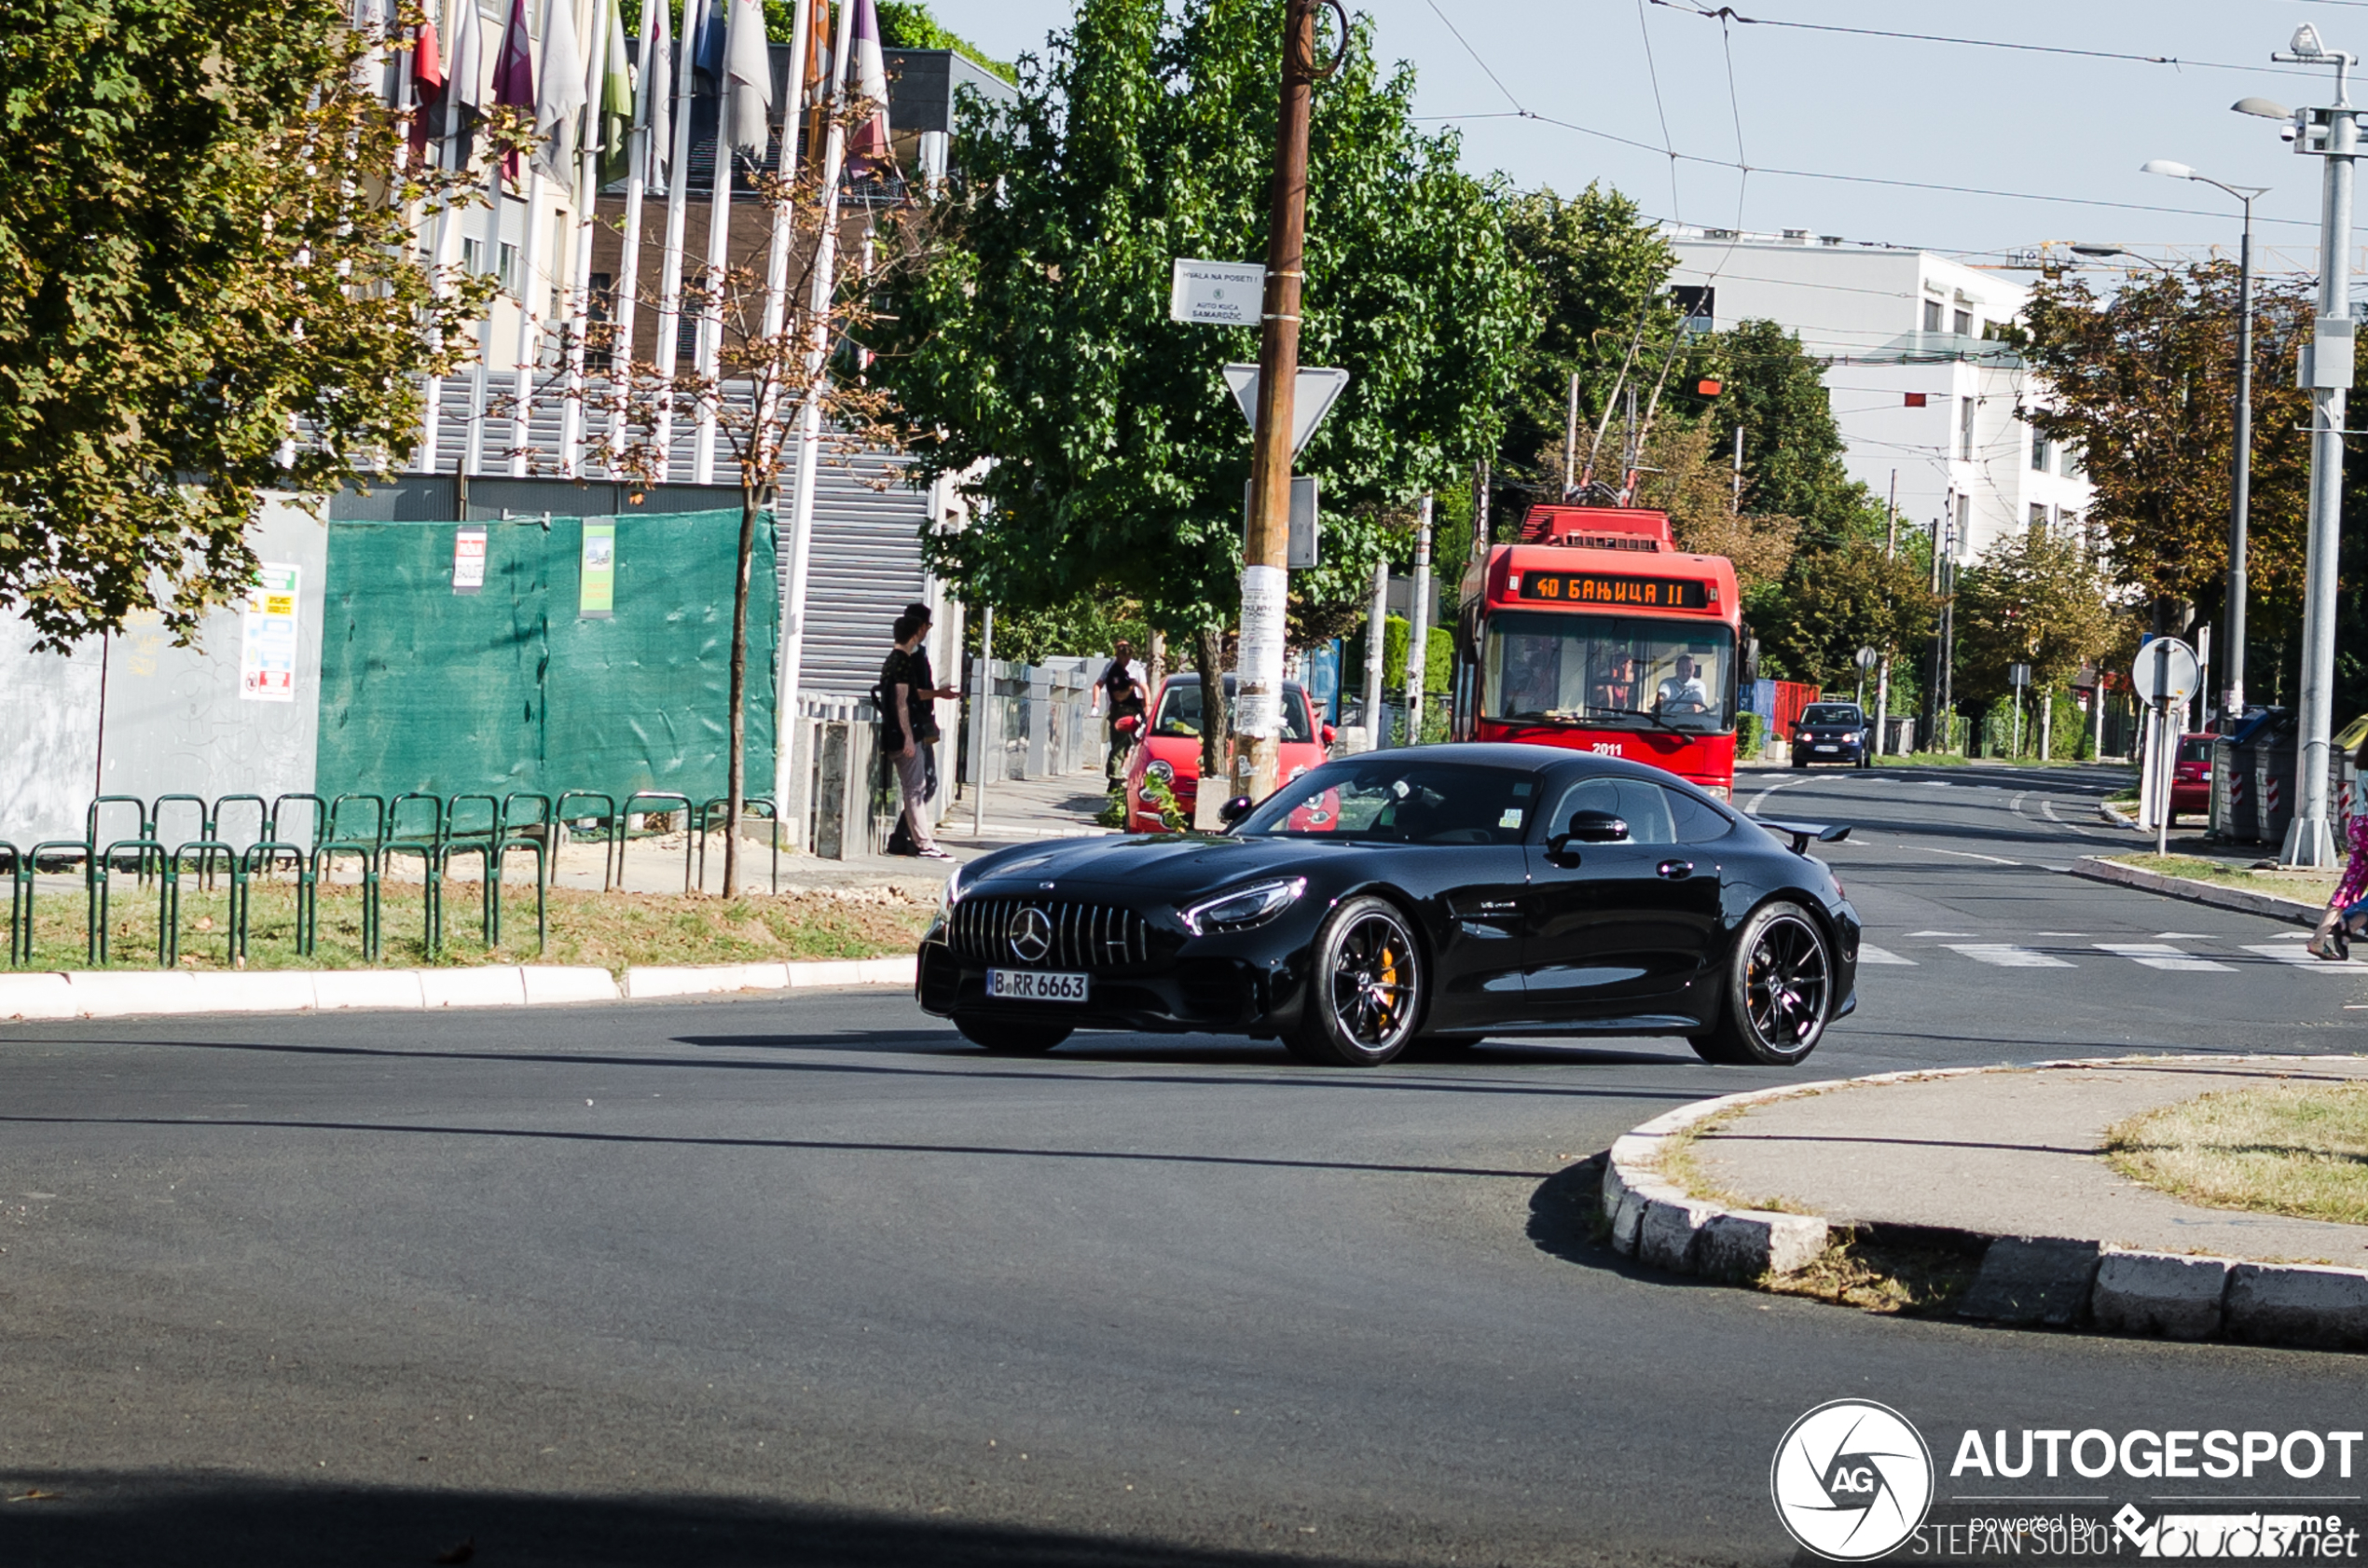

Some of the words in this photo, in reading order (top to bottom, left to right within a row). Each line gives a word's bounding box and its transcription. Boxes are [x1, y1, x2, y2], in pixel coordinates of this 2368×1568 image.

[1224, 274, 1253, 282] POSETI
[1537, 577, 1560, 598] 40
[1568, 579, 1657, 604] БАЊИЦА
[1591, 742, 1622, 757] 2011
[995, 971, 1004, 994] B
[1013, 973, 1033, 996] RR
[1037, 975, 1084, 998] 6663
